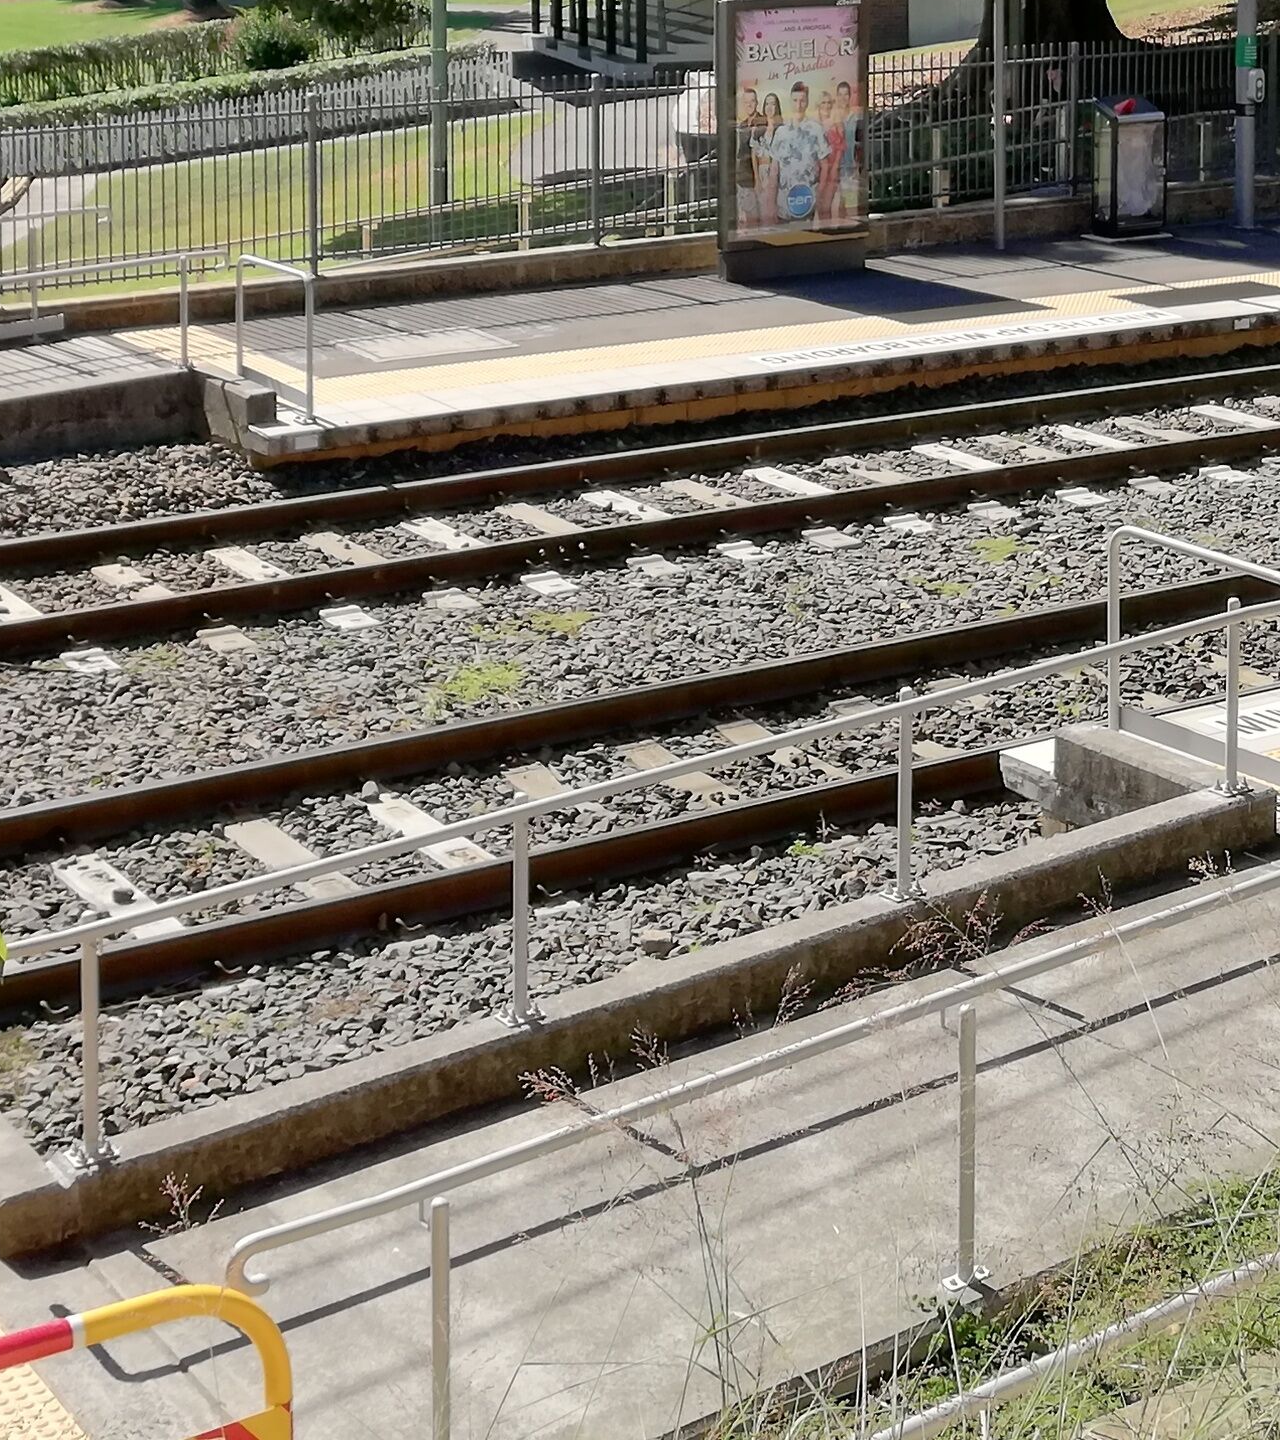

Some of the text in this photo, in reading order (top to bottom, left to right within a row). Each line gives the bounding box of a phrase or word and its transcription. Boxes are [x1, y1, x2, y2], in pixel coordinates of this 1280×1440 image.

[783, 57, 835, 80] Paradise
[761, 311, 1169, 364] MIND THE GAP WHEN BOARDING
